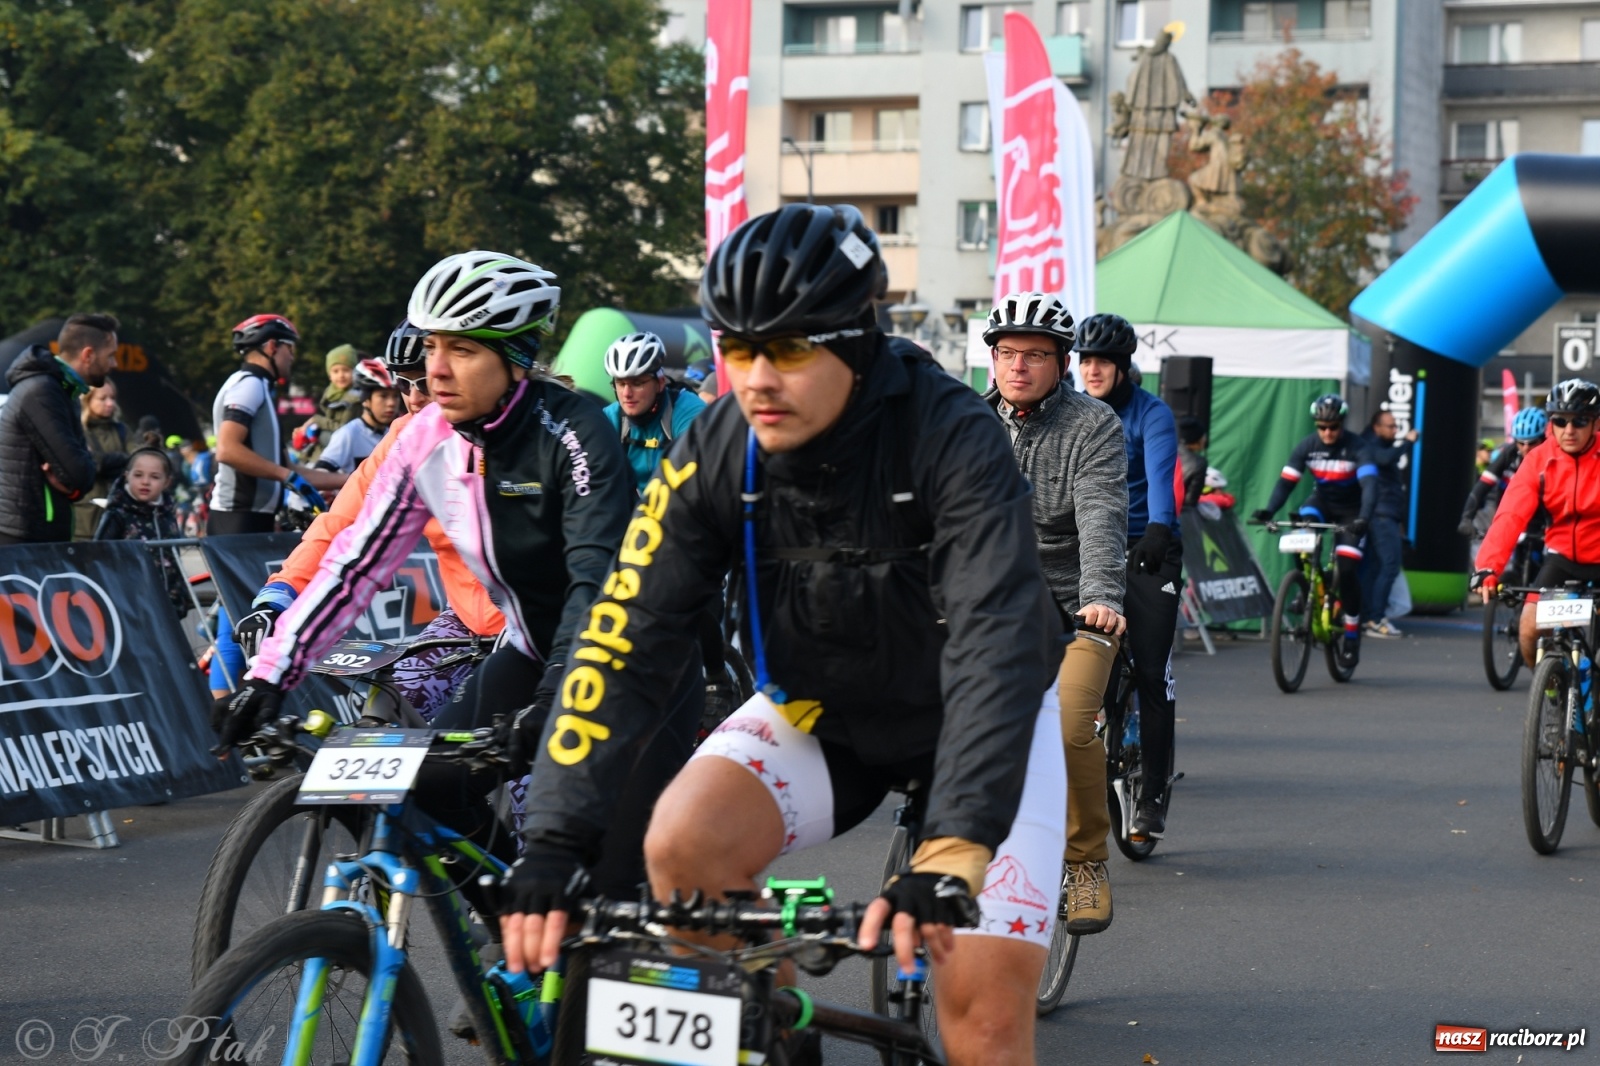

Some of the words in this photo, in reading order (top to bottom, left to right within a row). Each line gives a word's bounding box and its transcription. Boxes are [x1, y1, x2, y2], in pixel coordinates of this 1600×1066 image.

[459, 307, 491, 328] uvex
[1548, 604, 1583, 617] 3242
[323, 653, 371, 668] 302
[0, 721, 164, 793] NAJLEPSZYCH
[329, 757, 402, 780] 3243
[616, 1002, 712, 1050] 3178
